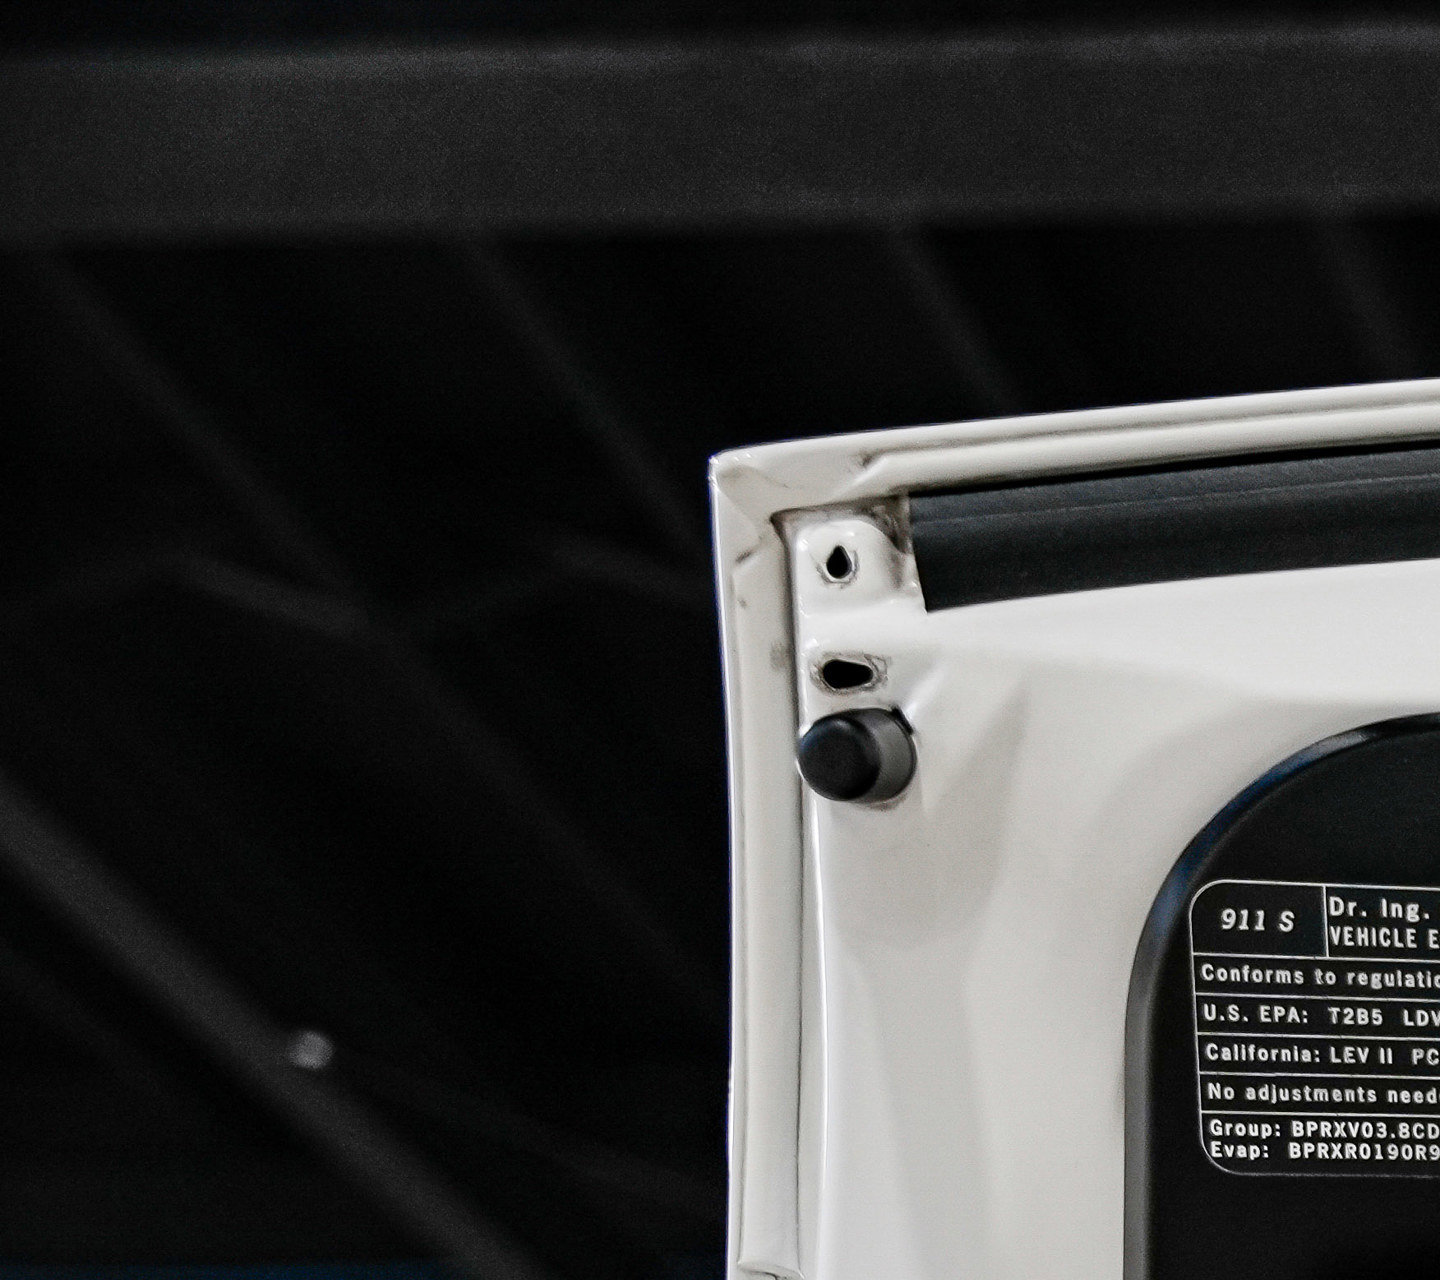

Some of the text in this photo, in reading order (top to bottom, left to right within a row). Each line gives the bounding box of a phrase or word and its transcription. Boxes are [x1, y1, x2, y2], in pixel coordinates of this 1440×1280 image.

[1220, 908, 1295, 932] 911 S
[1328, 896, 1367, 917] Dr.
[1380, 898, 1430, 922] Ing.
[1328, 926, 1417, 948] VEHICLE
[1201, 963, 1304, 984] Conforms
[1314, 968, 1336, 985] to
[1203, 1003, 1249, 1022] U.S.
[1259, 1005, 1308, 1024] EPA:
[1328, 1006, 1383, 1026] T2B5
[1205, 1043, 1440, 1066] California: LEV II PC
[1207, 1082, 1235, 1100] No
[1245, 1083, 1377, 1104] adjustments
[1210, 1118, 1281, 1138] Group:
[1210, 1141, 1269, 1161] Evap:
